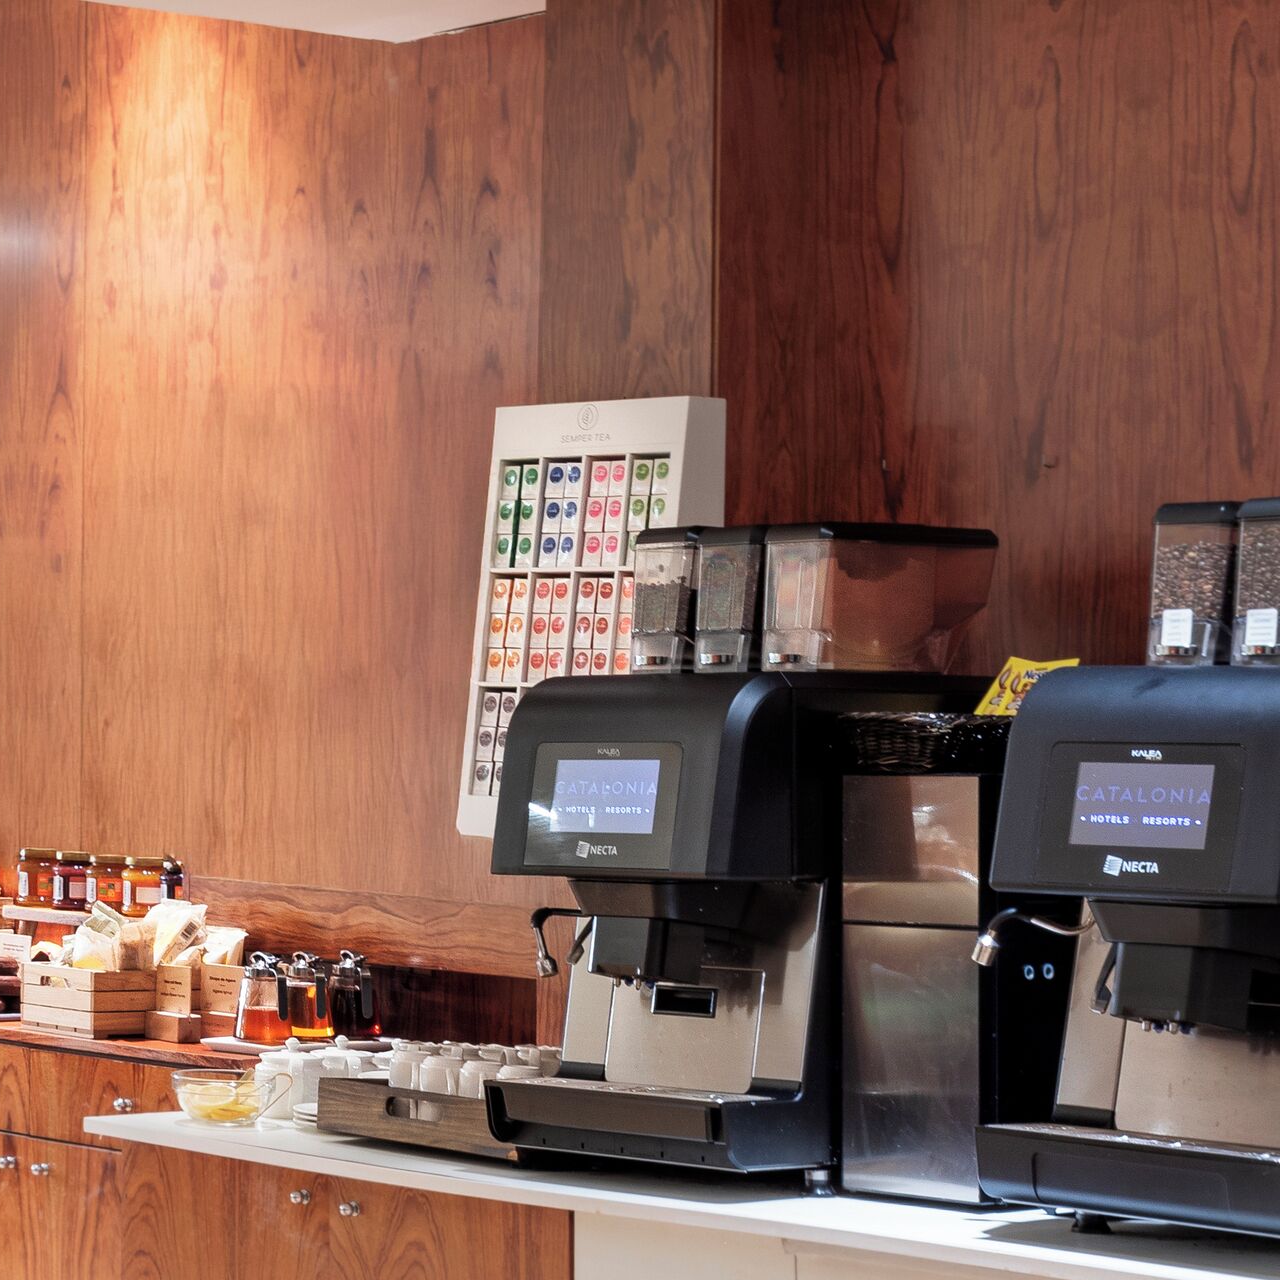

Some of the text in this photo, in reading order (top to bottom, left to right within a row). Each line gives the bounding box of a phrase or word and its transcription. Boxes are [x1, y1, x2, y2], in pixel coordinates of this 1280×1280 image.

[560, 433, 611, 444] SEMPER TEA
[1131, 749, 1163, 759] KALEA
[555, 781, 657, 795] CATALONIA
[1076, 785, 1211, 804] CATALONIA
[565, 806, 642, 815] HOTELS RESORTS
[1090, 814, 1191, 826] HOTELS RESORTS
[589, 845, 618, 856] NECTA
[1121, 861, 1159, 874] NECTA
